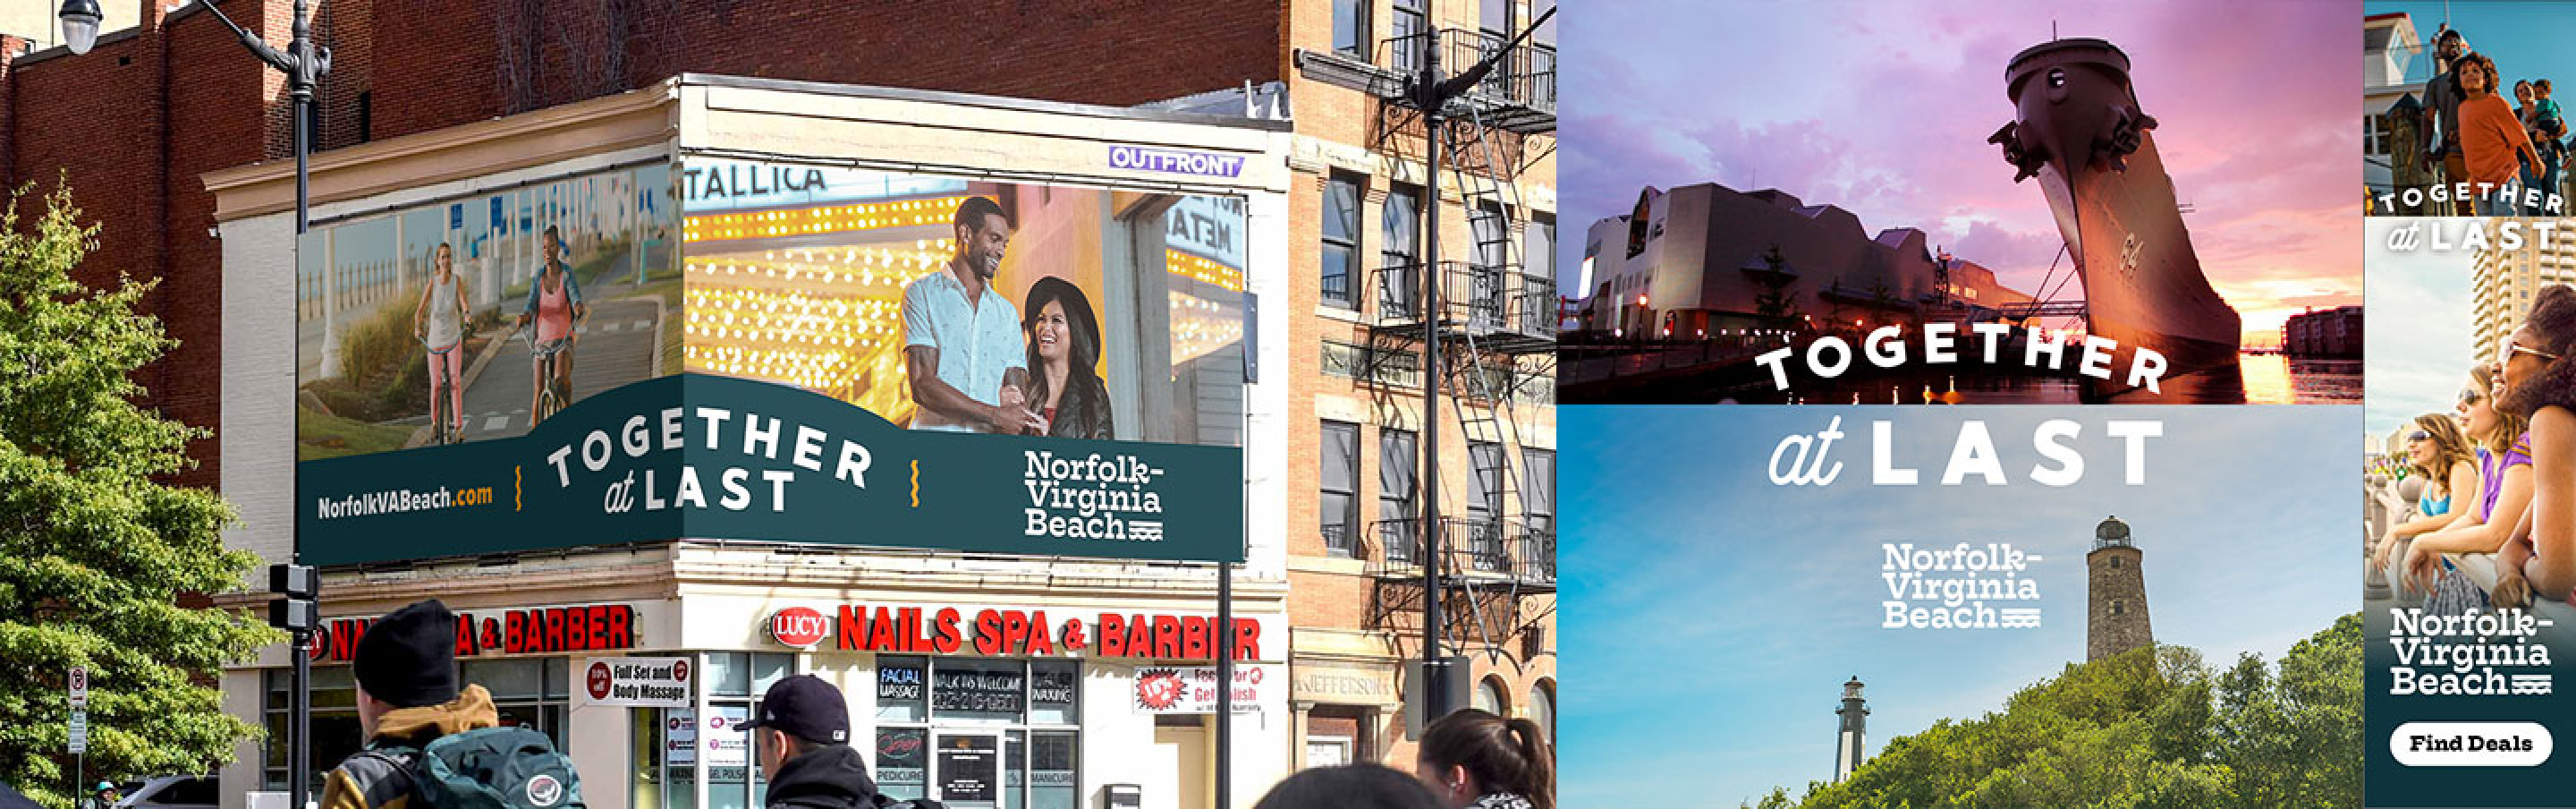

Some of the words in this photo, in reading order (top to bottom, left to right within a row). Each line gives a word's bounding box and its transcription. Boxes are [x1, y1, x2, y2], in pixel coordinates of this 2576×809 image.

[1112, 147, 1240, 176] OUTFRONT
[547, 406, 873, 490] TOGETHER
[1024, 450, 1164, 485] Norfolk-
[318, 484, 493, 520] NorfolkVABeach.com
[604, 476, 636, 514] at
[644, 466, 795, 513] LAST
[1024, 480, 1162, 519] Virginia
[1024, 507, 1126, 541] Beach
[480, 617, 501, 649] &
[504, 604, 630, 654] BARBER
[776, 616, 824, 636] LUCY
[838, 604, 962, 654] NAILS
[976, 609, 1054, 655] SPA
[1063, 617, 1088, 651] &
[632, 664, 650, 680] Set
[613, 683, 639, 700] Body
[640, 683, 685, 702] Massage
